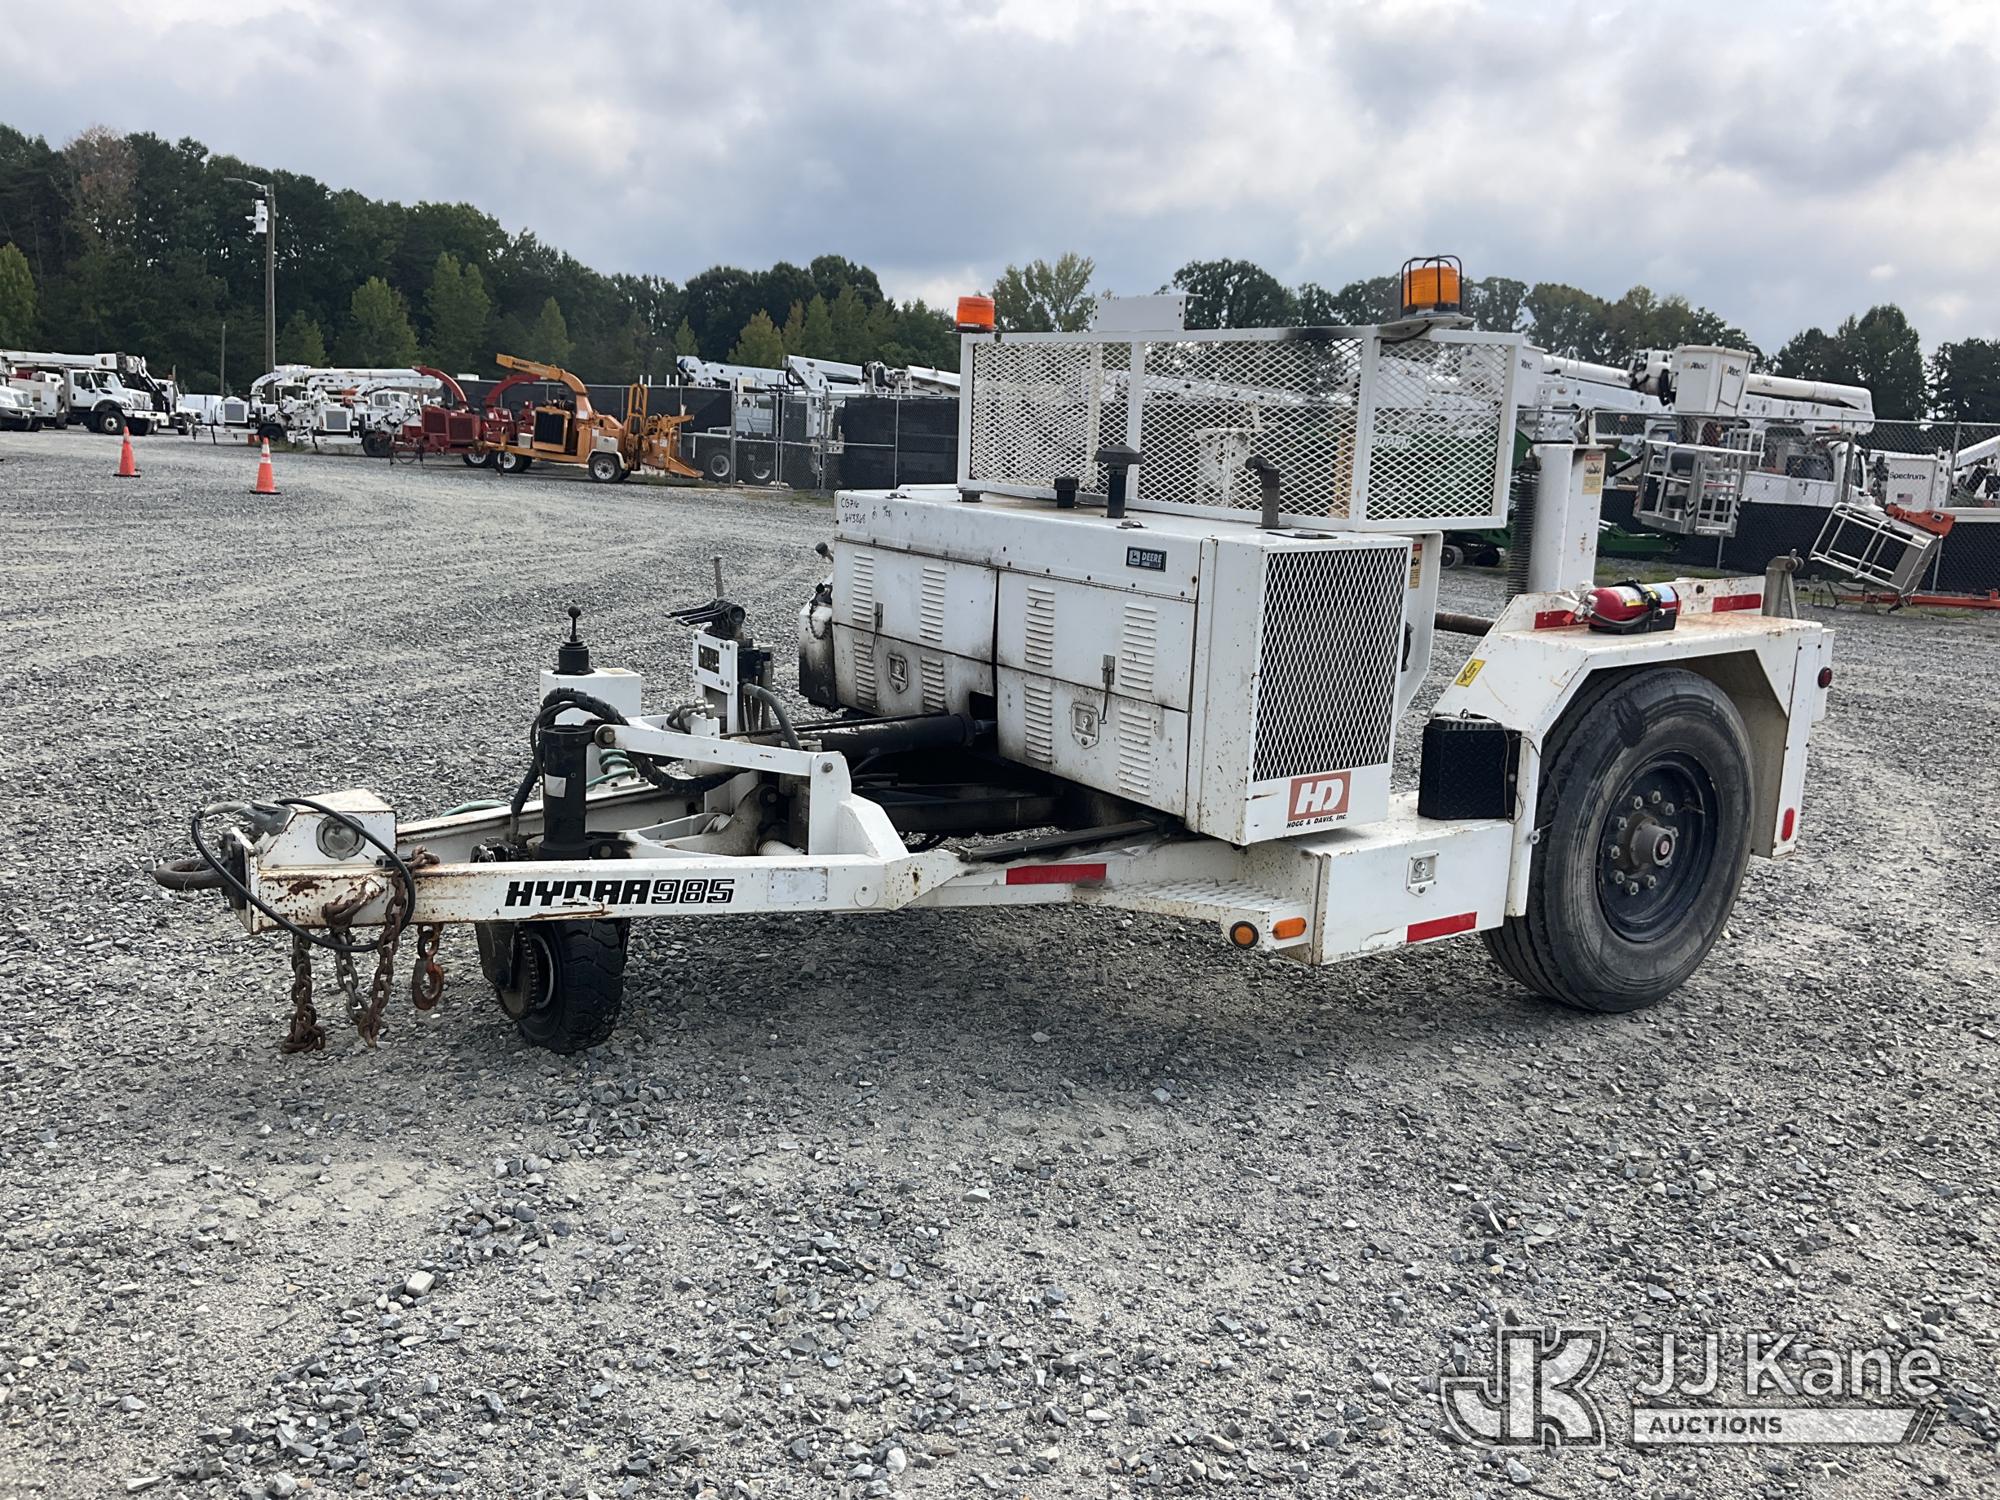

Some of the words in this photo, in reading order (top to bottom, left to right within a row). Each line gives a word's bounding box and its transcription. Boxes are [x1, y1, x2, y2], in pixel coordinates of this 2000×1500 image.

[1889, 472, 1924, 480] Spectrum
[1141, 552, 1163, 563] DEERE
[1295, 778, 1344, 814] HD
